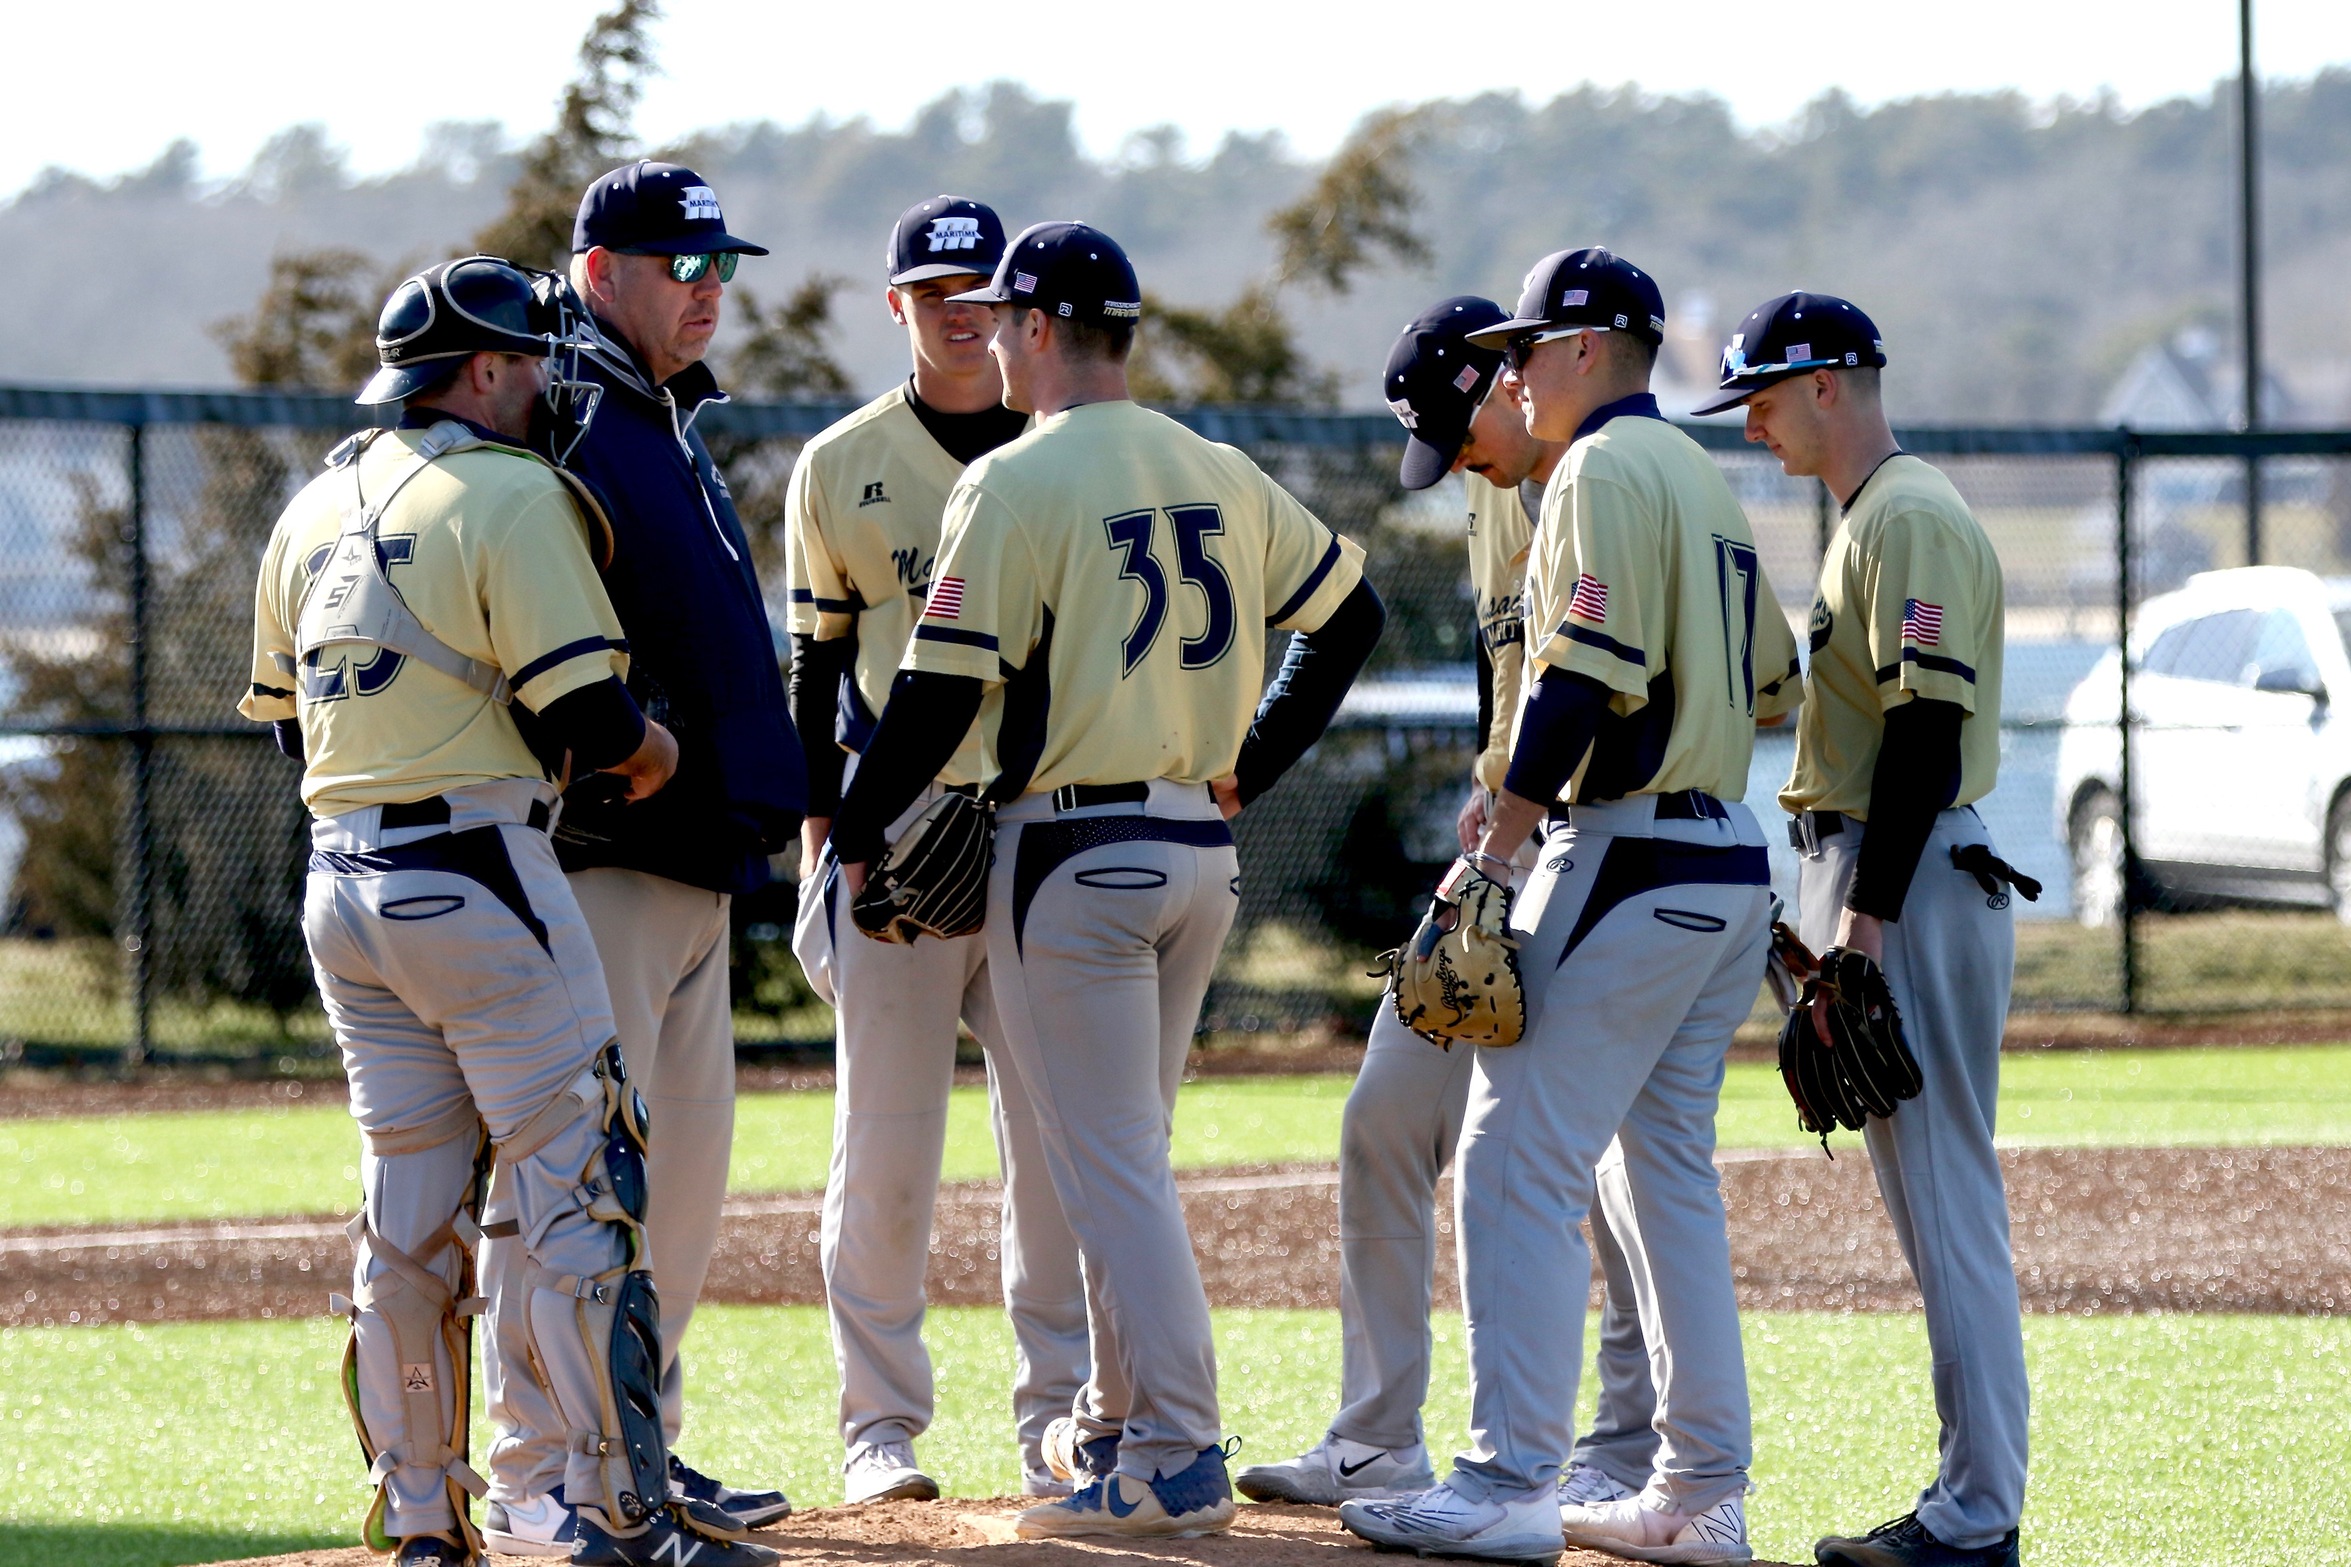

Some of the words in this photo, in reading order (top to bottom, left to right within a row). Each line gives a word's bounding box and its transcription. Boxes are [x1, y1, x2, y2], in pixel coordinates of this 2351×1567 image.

[859, 496, 892, 508] RUSSELL
[1103, 503, 1237, 681] 35
[1711, 533, 1760, 717] 17
[1435, 946, 1463, 1028] Rawlings
